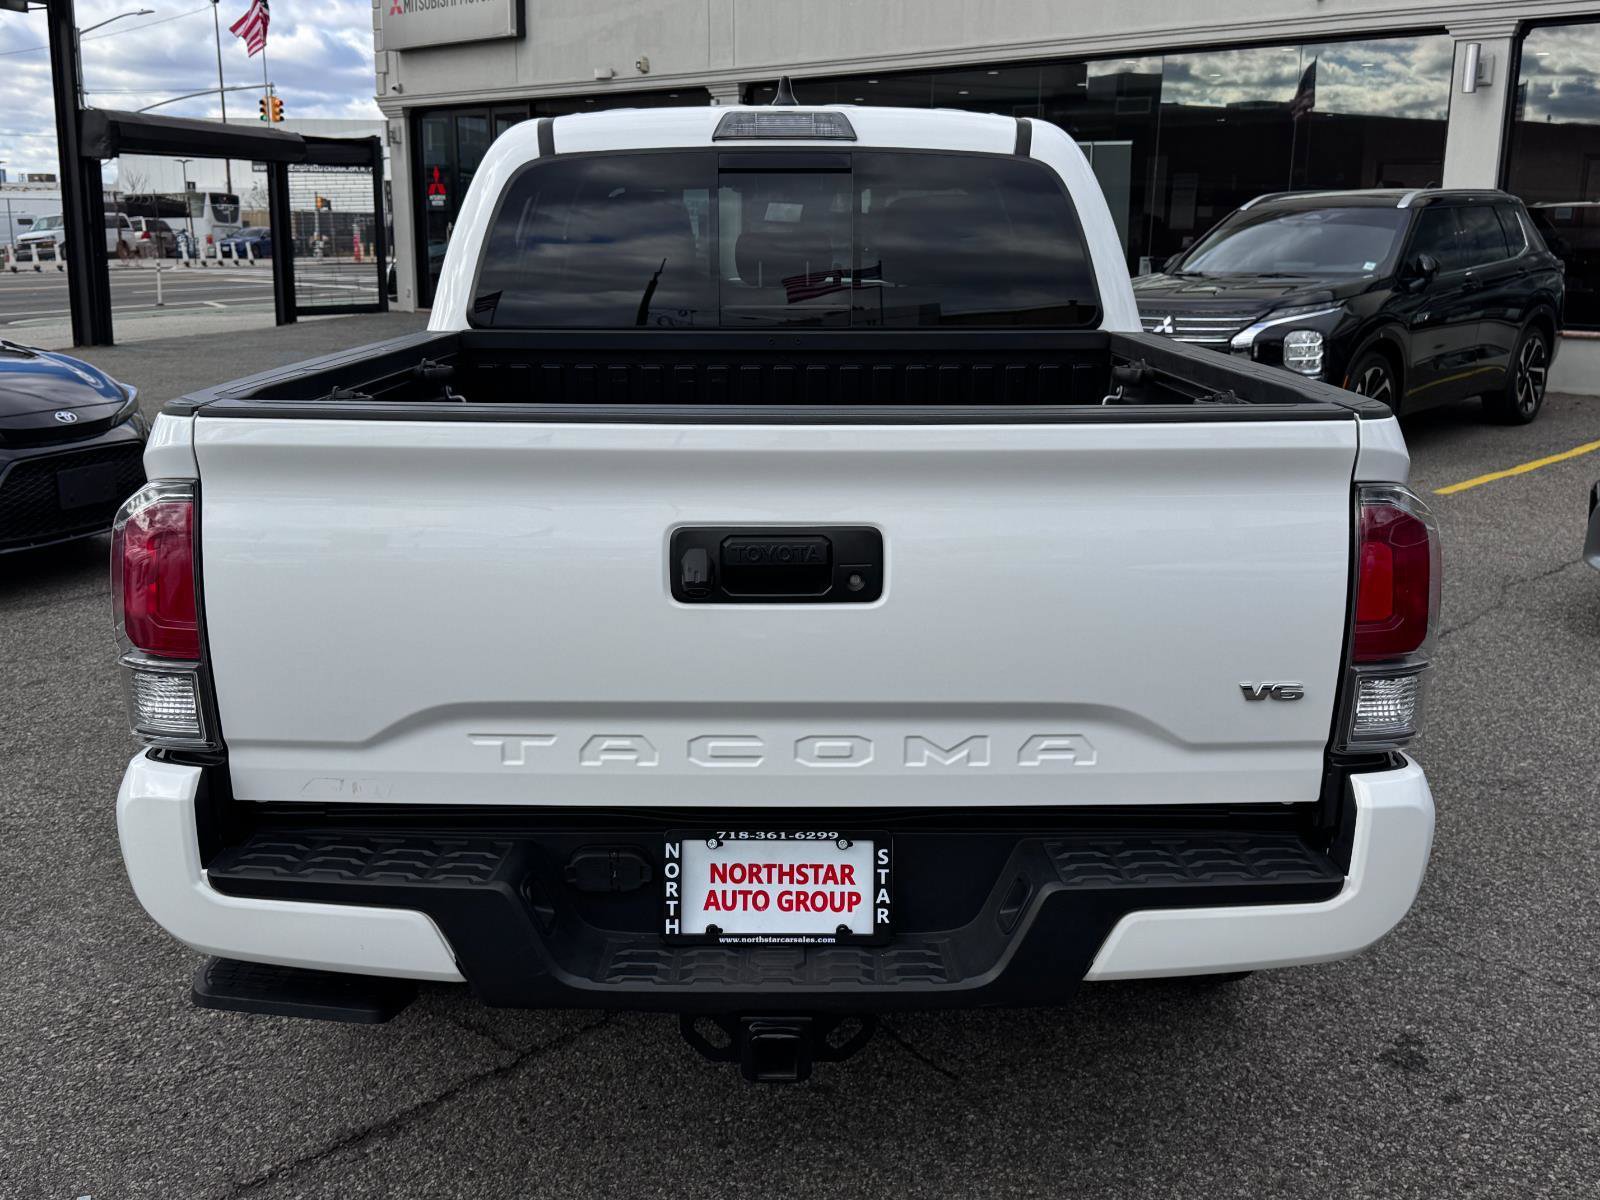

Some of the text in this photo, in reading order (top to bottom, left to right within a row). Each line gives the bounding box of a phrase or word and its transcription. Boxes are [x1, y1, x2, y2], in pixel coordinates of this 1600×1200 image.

[735, 544, 821, 562] TOYOTA
[1239, 681, 1305, 701] V6
[467, 733, 1098, 767] TACOMA
[716, 831, 839, 840] 718-361-6299
[710, 863, 856, 885] NORTHSTAR
[664, 842, 680, 934] NORTH
[876, 848, 890, 924] STAR
[703, 889, 862, 912] AUTO GROUP
[719, 935, 836, 944] www.northstarcarsales.com
